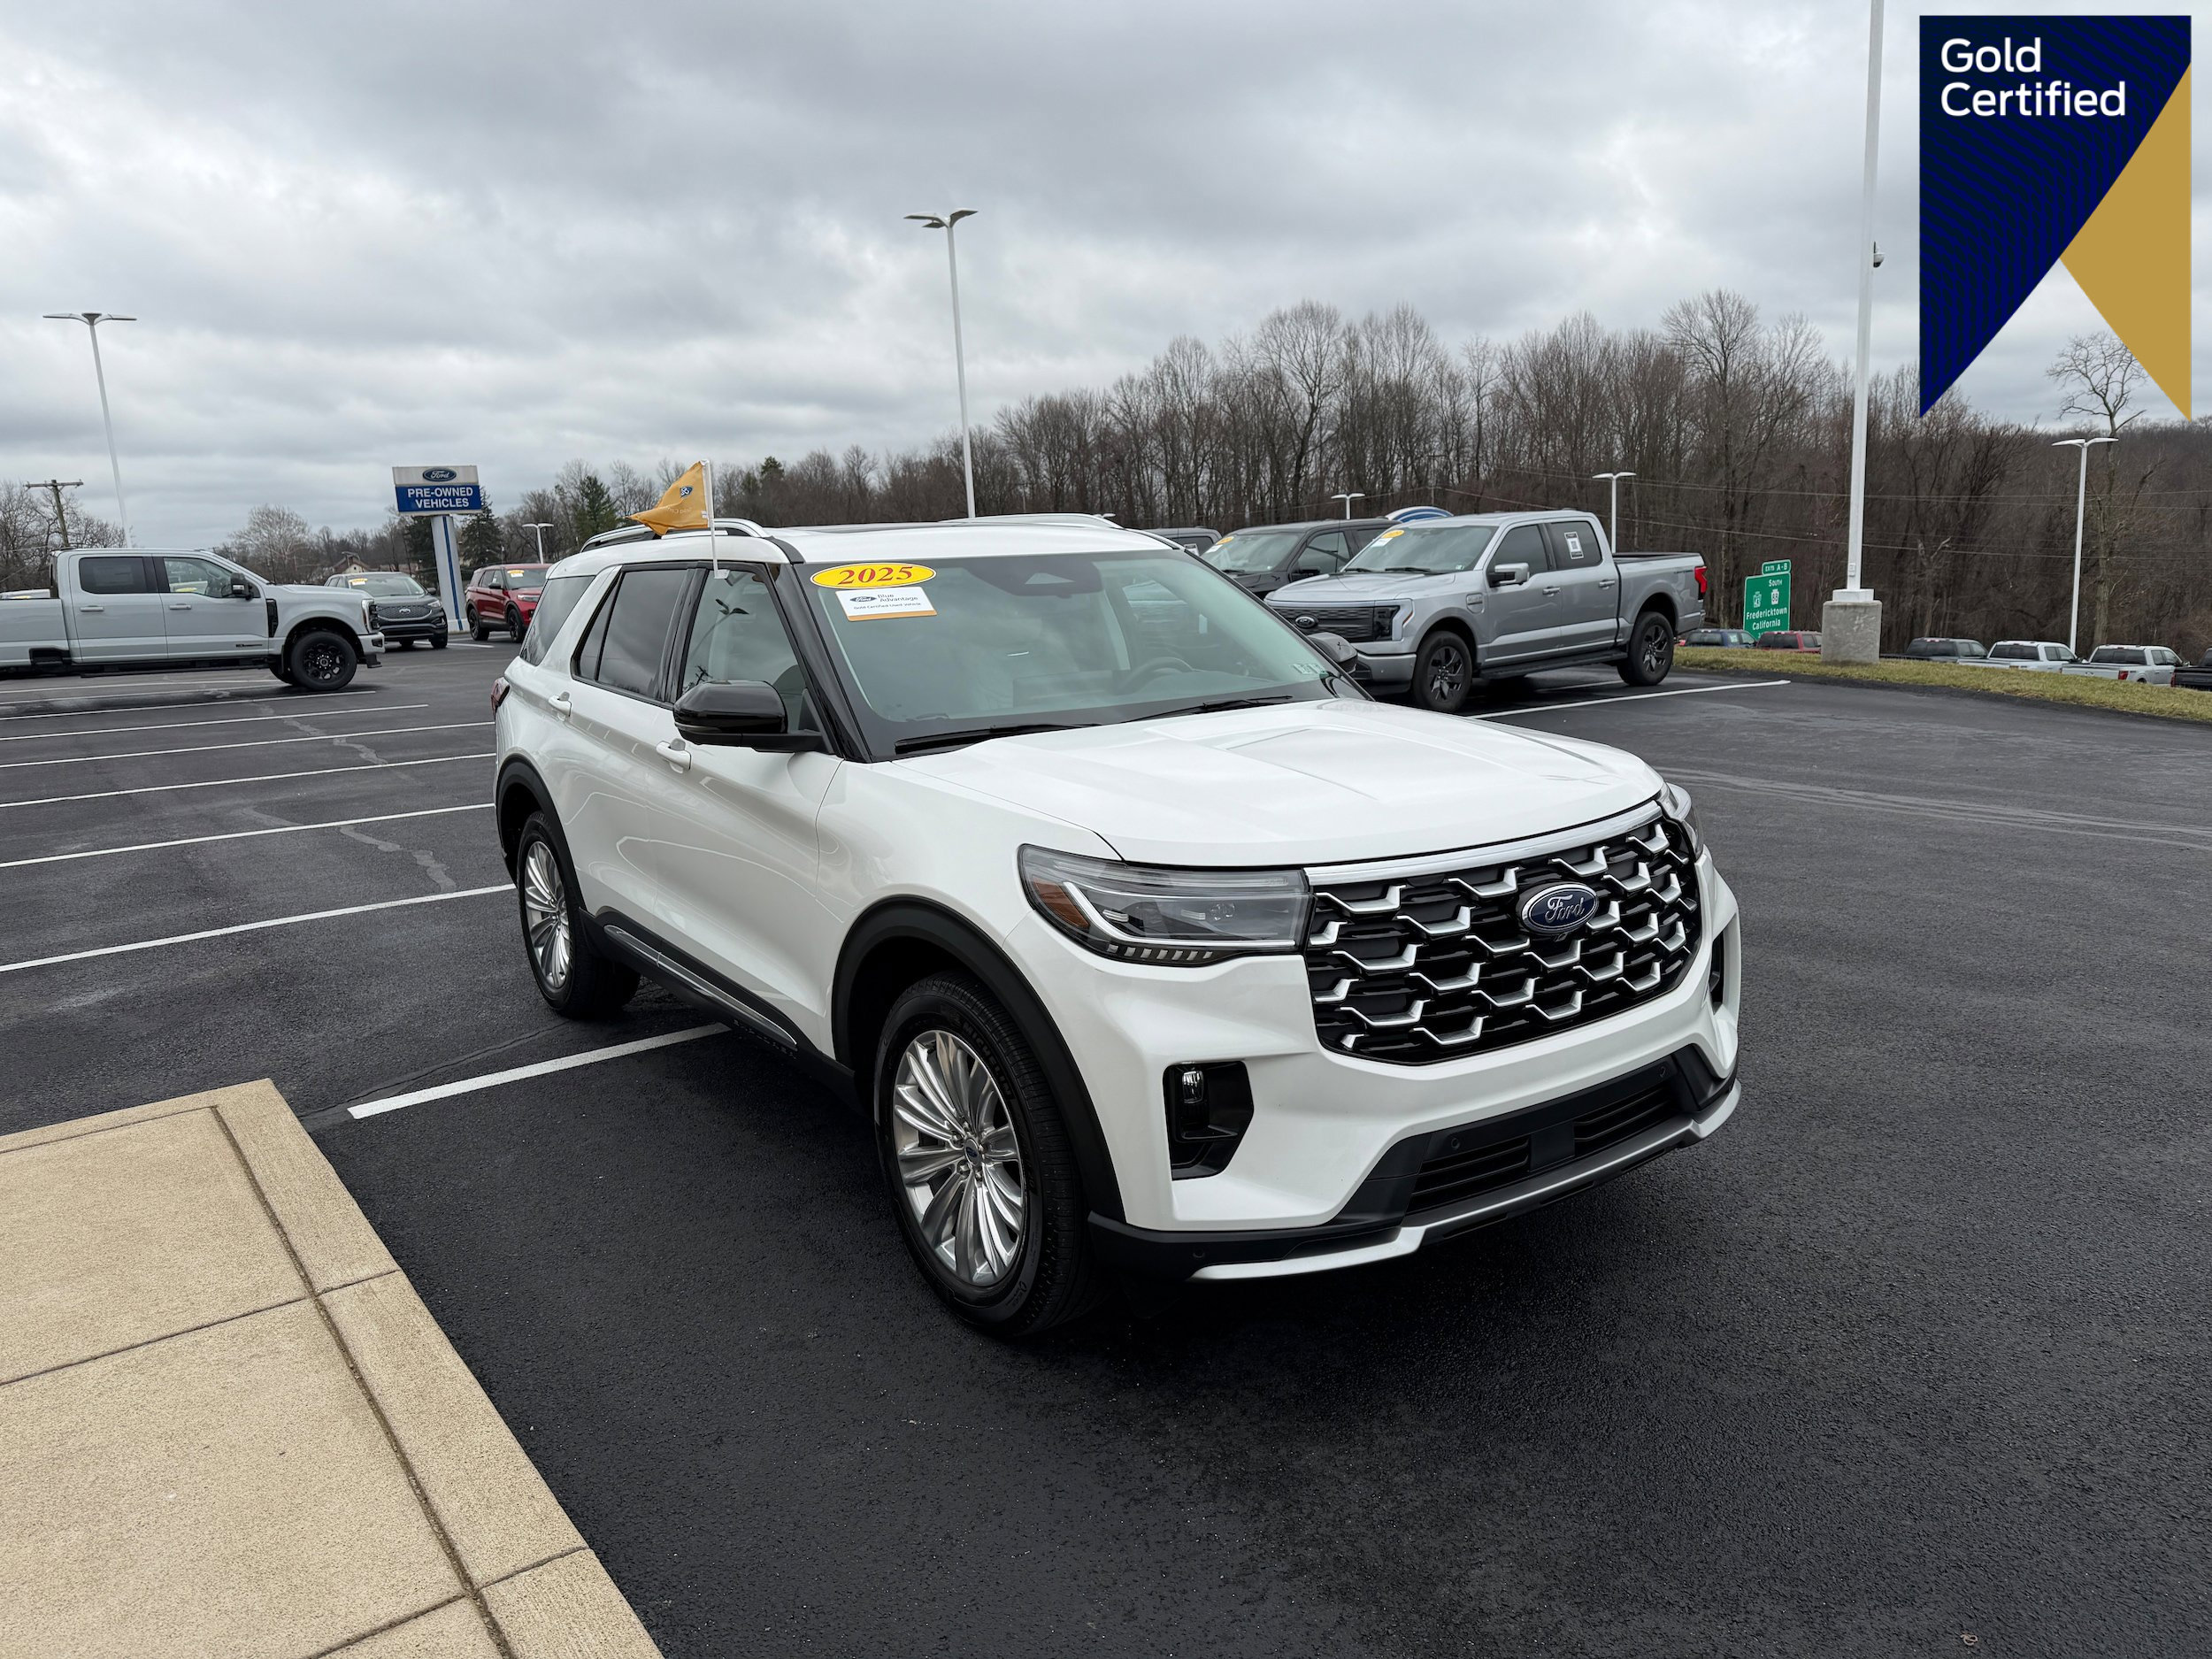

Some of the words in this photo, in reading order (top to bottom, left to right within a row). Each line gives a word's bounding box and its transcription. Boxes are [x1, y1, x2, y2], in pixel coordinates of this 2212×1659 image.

[430, 470, 450, 479] Ford
[407, 487, 473, 498] PRE-OWNED
[415, 497, 470, 509] VEHICLES
[838, 566, 913, 585] 2025
[1746, 607, 1787, 619] Fredericktown
[1752, 618, 1780, 630] California
[1545, 894, 1586, 924] Ford
